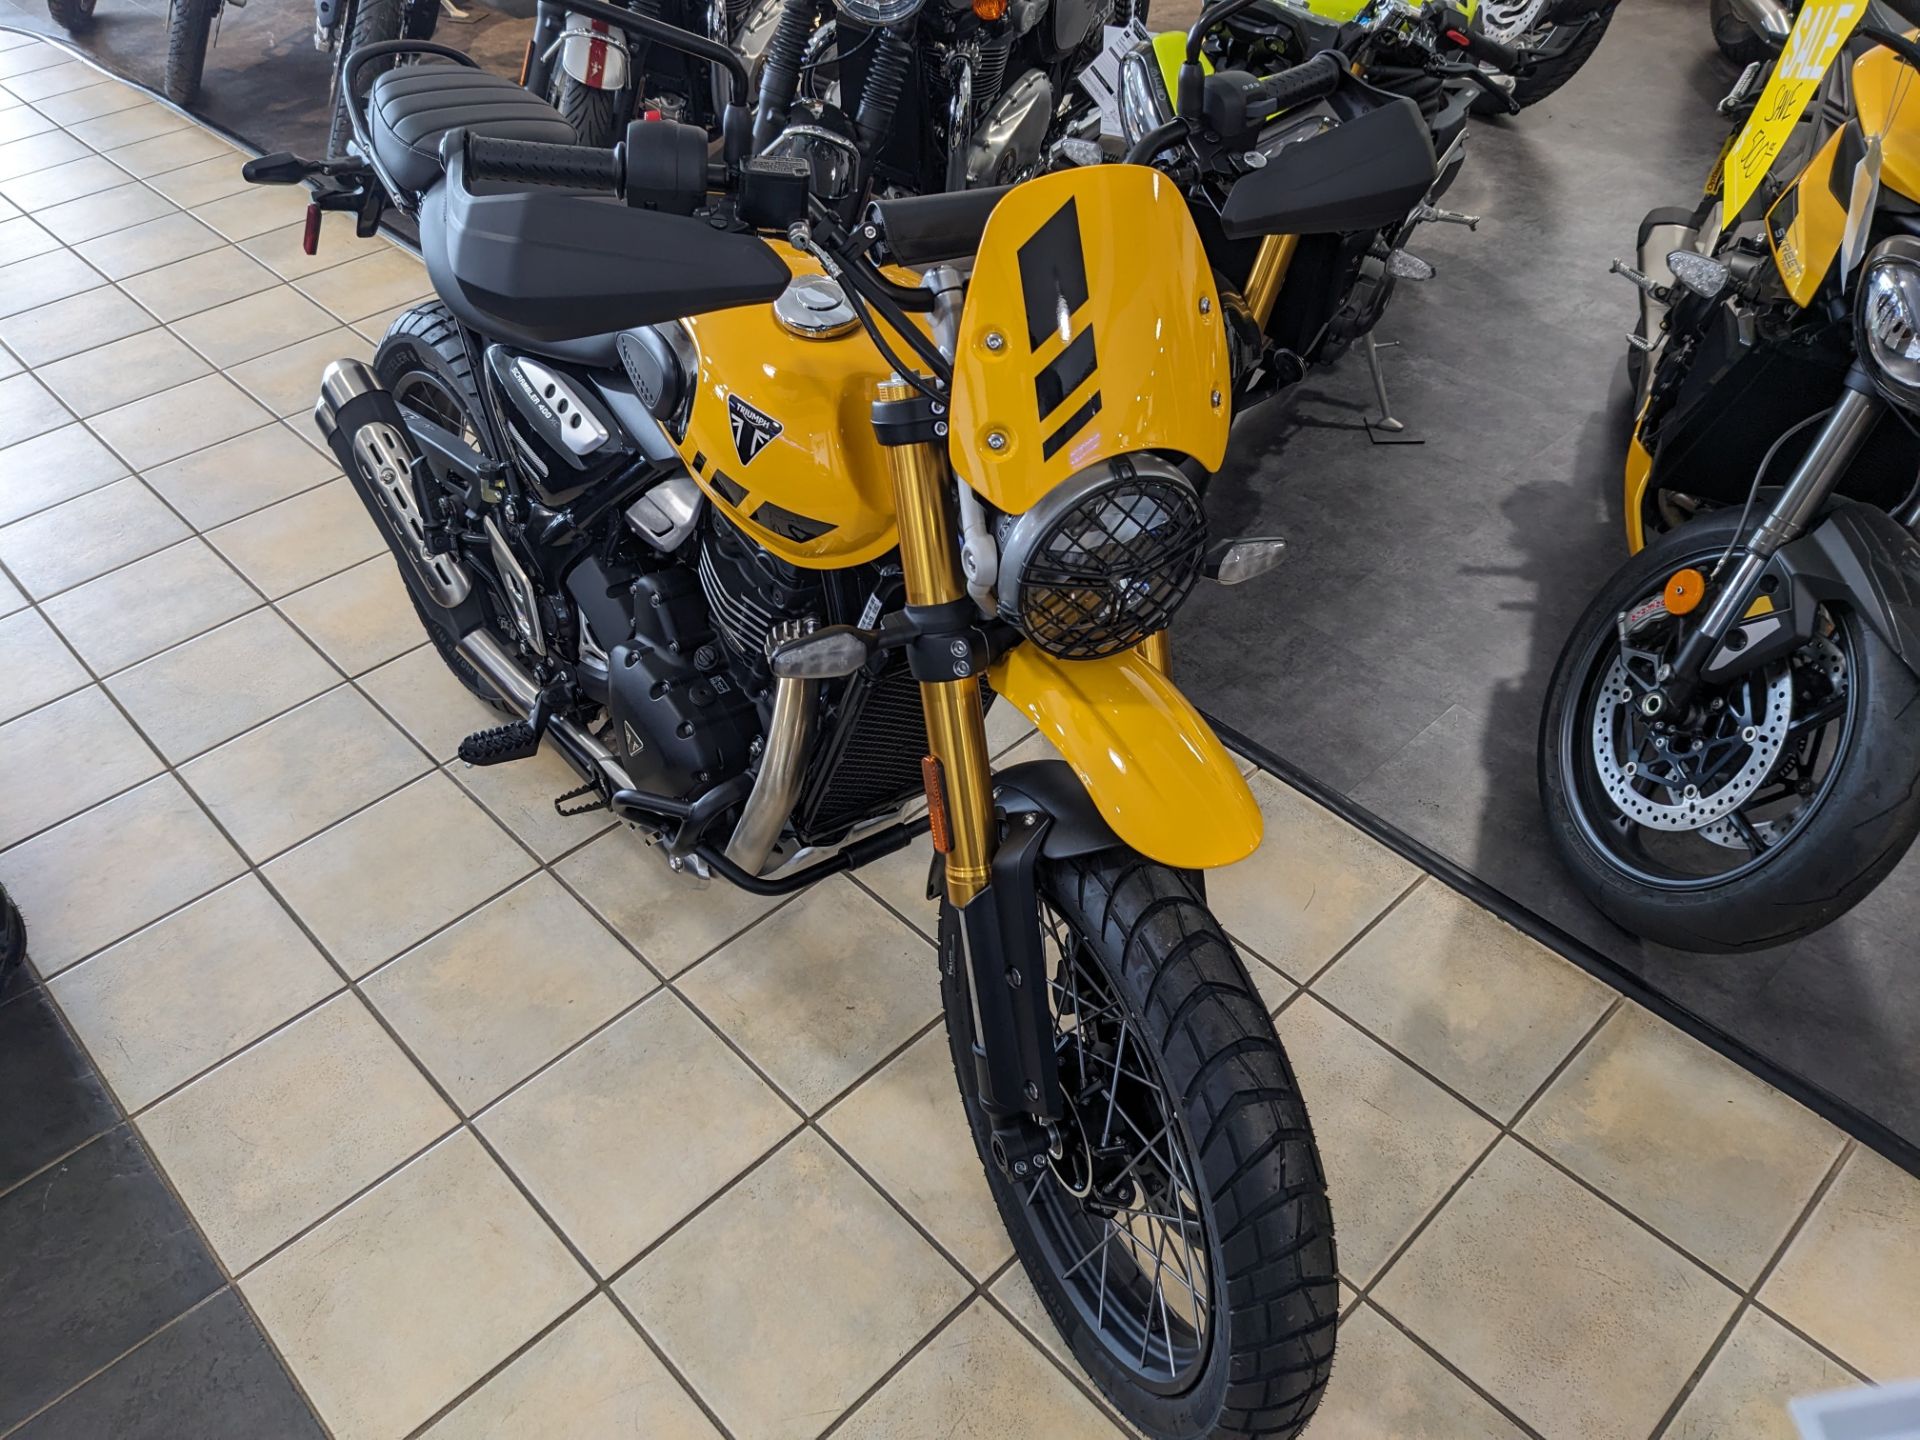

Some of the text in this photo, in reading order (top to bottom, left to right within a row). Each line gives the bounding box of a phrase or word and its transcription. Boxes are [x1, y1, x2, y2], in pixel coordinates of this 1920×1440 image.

[1780, 4, 1856, 80] SALE
[1764, 83, 1803, 121] SAVE
[1775, 228, 1802, 277] STREET
[511, 367, 541, 405] SCRAMBLER
[538, 404, 553, 420] 400
[736, 402, 770, 429] TRIUMPH
